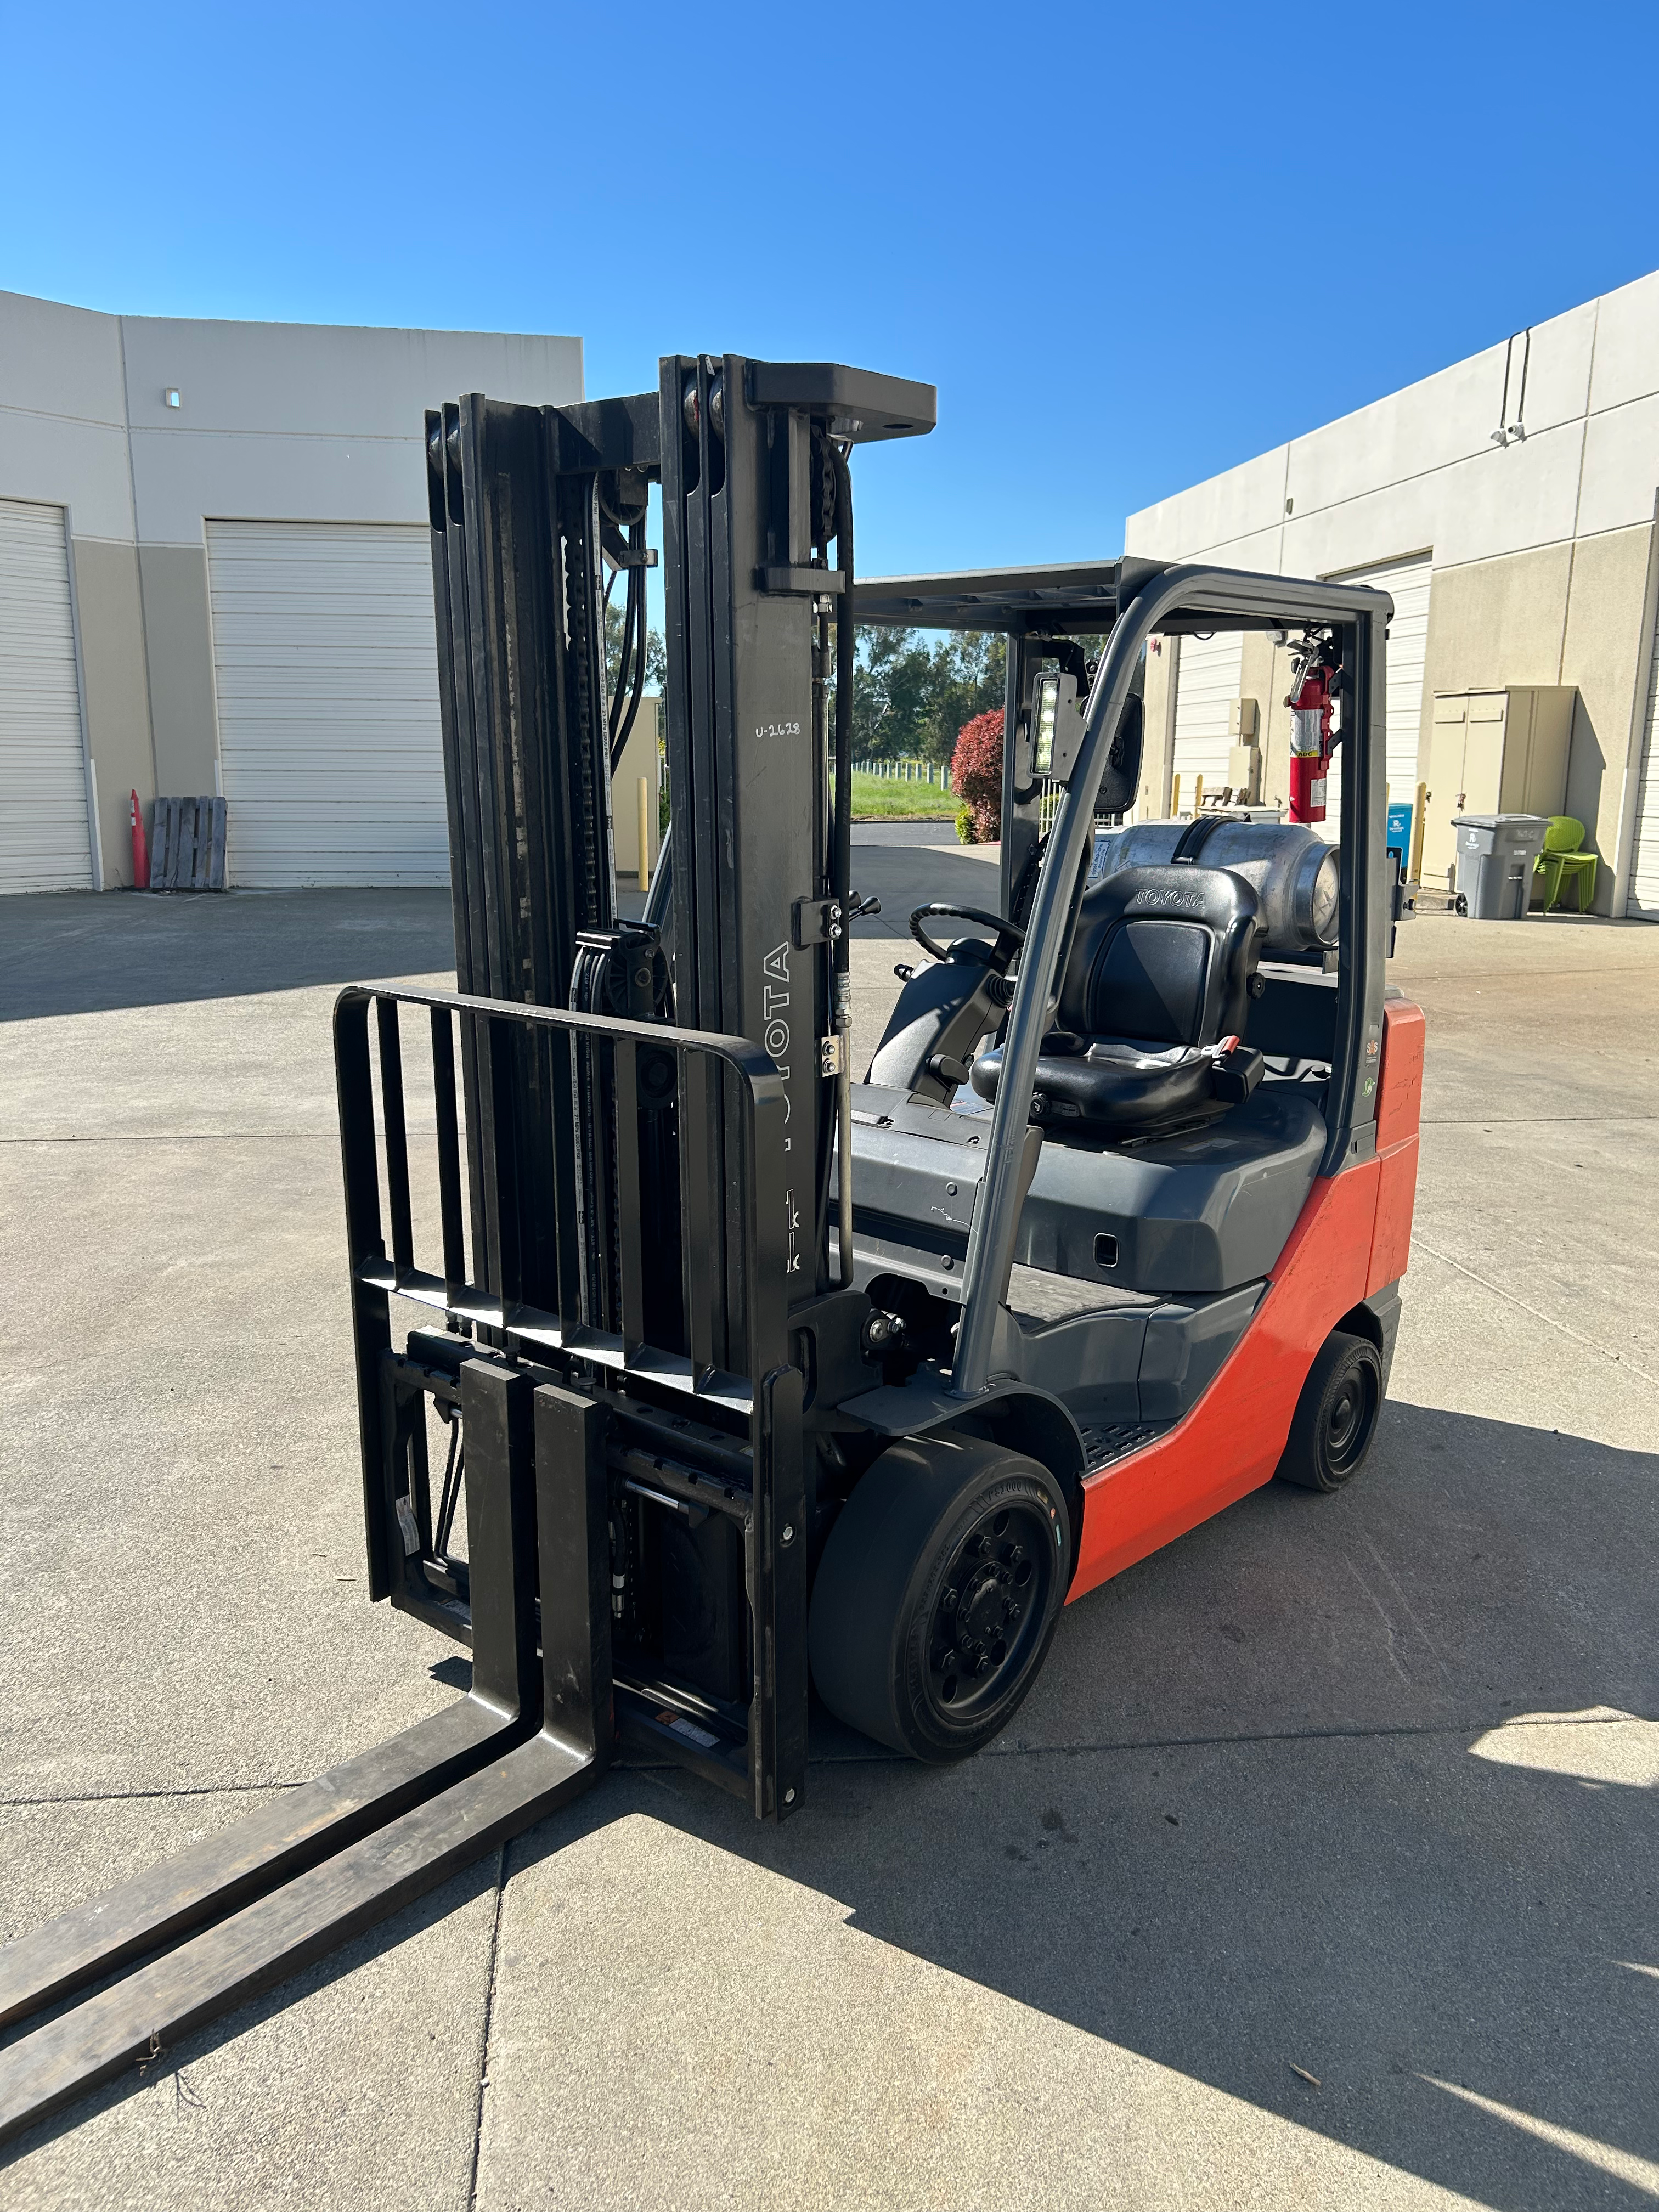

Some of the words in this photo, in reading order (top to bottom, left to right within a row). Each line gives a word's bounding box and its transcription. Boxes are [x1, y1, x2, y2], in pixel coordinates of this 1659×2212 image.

[755, 722, 800, 738] U-2628
[1135, 888, 1206, 909] TOYOTA
[763, 941, 791, 1152] OTA
